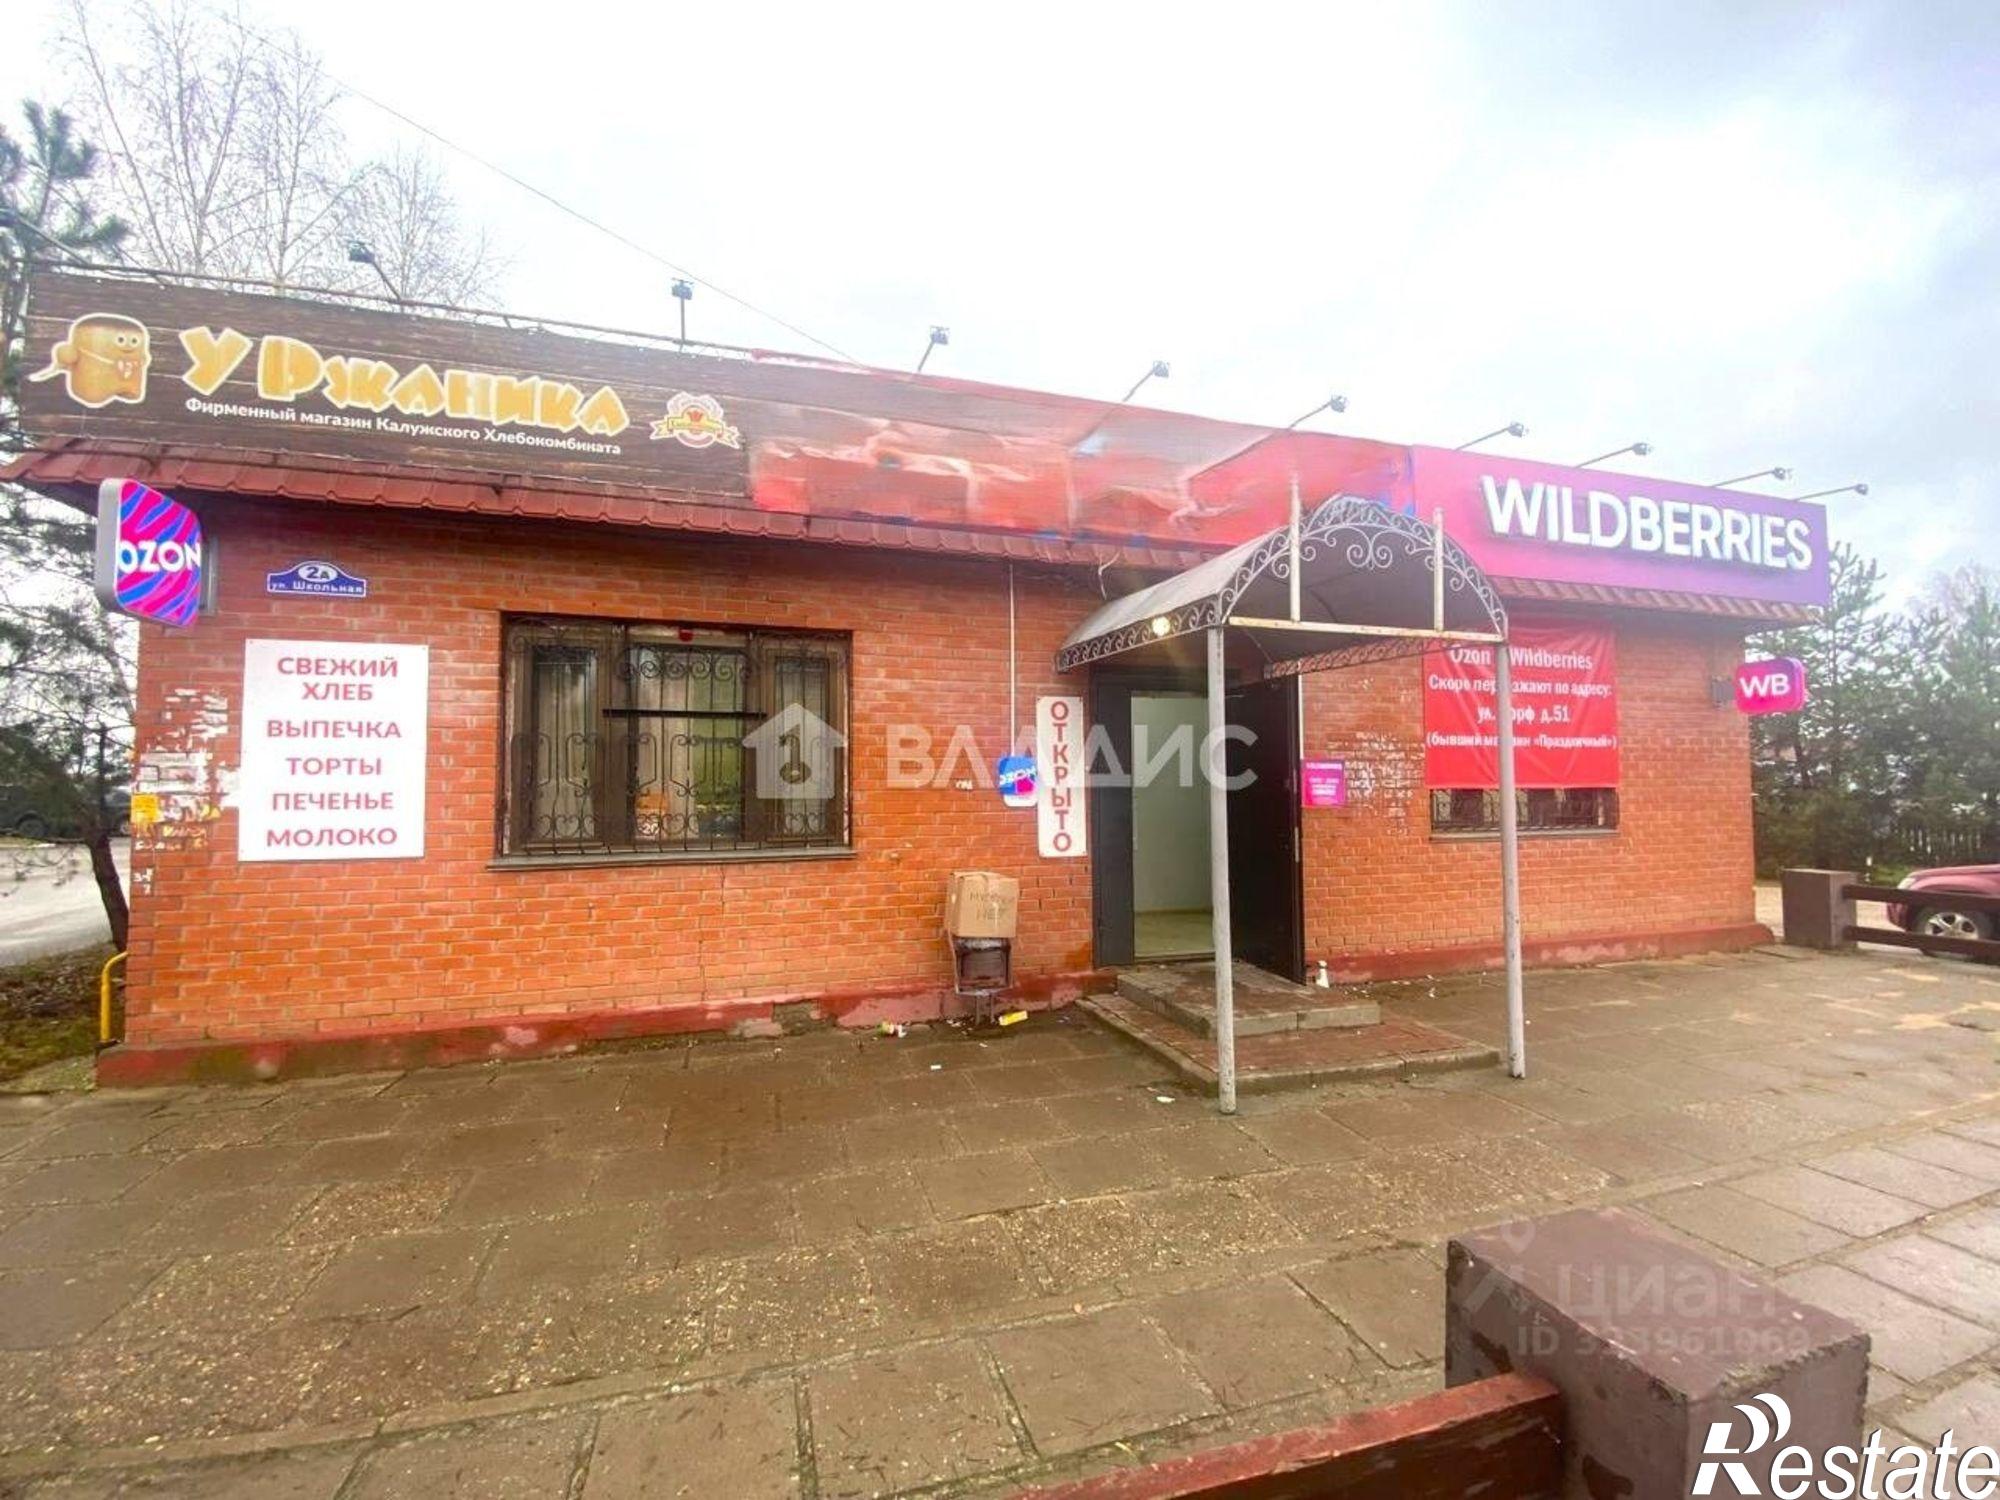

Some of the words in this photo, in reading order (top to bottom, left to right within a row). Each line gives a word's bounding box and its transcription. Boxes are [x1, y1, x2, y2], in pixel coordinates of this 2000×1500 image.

[179, 326, 253, 396] У
[185, 397, 296, 422] Фирменный
[300, 411, 372, 430] магазин
[376, 416, 481, 441] Калужского
[483, 426, 621, 456] Хлебокомбината
[1480, 474, 1813, 571] WILDBERRIES
[117, 539, 201, 575] OZON
[293, 580, 363, 593] Школьная
[277, 655, 398, 678] СВЕЖИЙ
[1508, 646, 1593, 670] Wildberries
[301, 682, 373, 701] ХЛЕБ
[1739, 673, 1790, 701] WB
[1540, 704, 1570, 724] д.51
[266, 719, 402, 739] ВЫПЕЧКА
[286, 757, 381, 776] ТОРТЫ
[1049, 700, 1074, 853] ОТКРЫТО
[272, 792, 394, 811] ПЕЧЕНЬЕ
[266, 828, 397, 847] МОЛОКО
